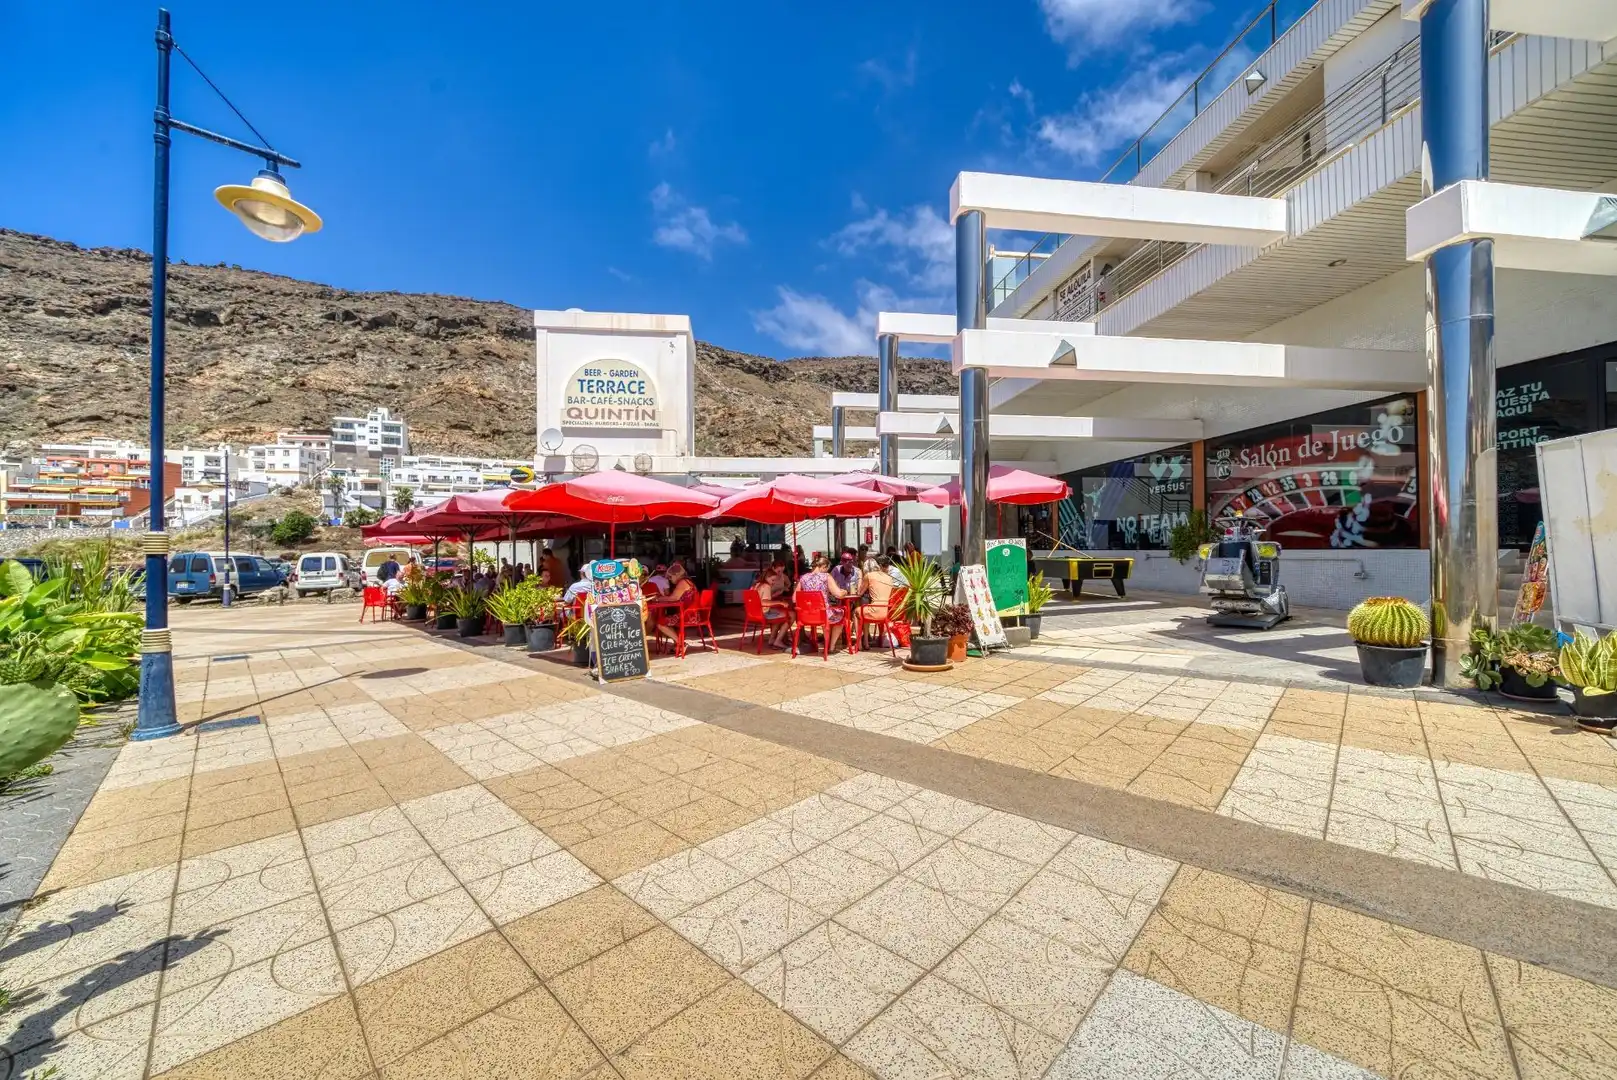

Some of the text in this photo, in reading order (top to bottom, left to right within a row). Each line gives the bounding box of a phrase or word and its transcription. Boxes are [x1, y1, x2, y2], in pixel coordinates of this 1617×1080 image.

[584, 368, 639, 378] BEER GARDEN
[577, 379, 646, 394] TERRACE
[1496, 381, 1543, 399] AZ TU
[1496, 391, 1551, 409] UESTA
[566, 406, 657, 421] QUINTÍN
[1498, 426, 1541, 441] PORT
[1239, 426, 1405, 471] Salón de Juego
[1279, 476, 1297, 491] 35
[1302, 473, 1312, 487] 3
[1321, 471, 1338, 486] 26
[1149, 482, 1185, 495] VERSUS
[1116, 511, 1190, 532] NO TEAM
